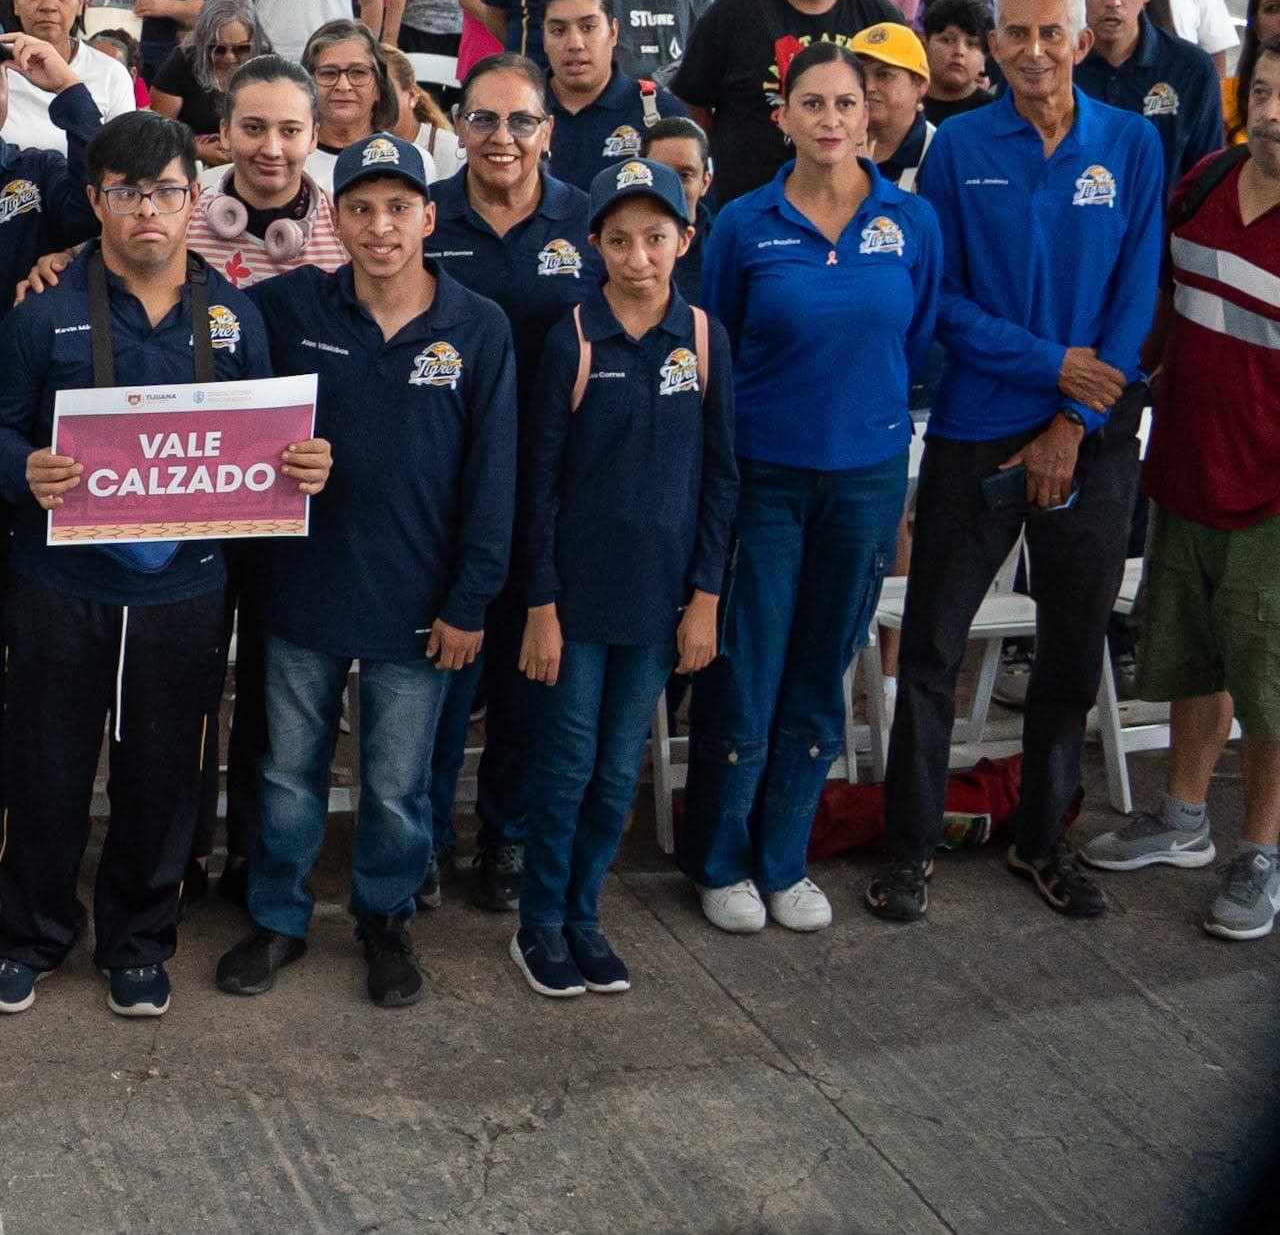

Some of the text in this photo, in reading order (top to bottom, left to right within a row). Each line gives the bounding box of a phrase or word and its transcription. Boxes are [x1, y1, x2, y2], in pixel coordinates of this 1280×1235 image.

[146, 393, 177, 401] TIJUANA
[138, 431, 222, 459] VALE
[87, 463, 276, 498] CALZADO
